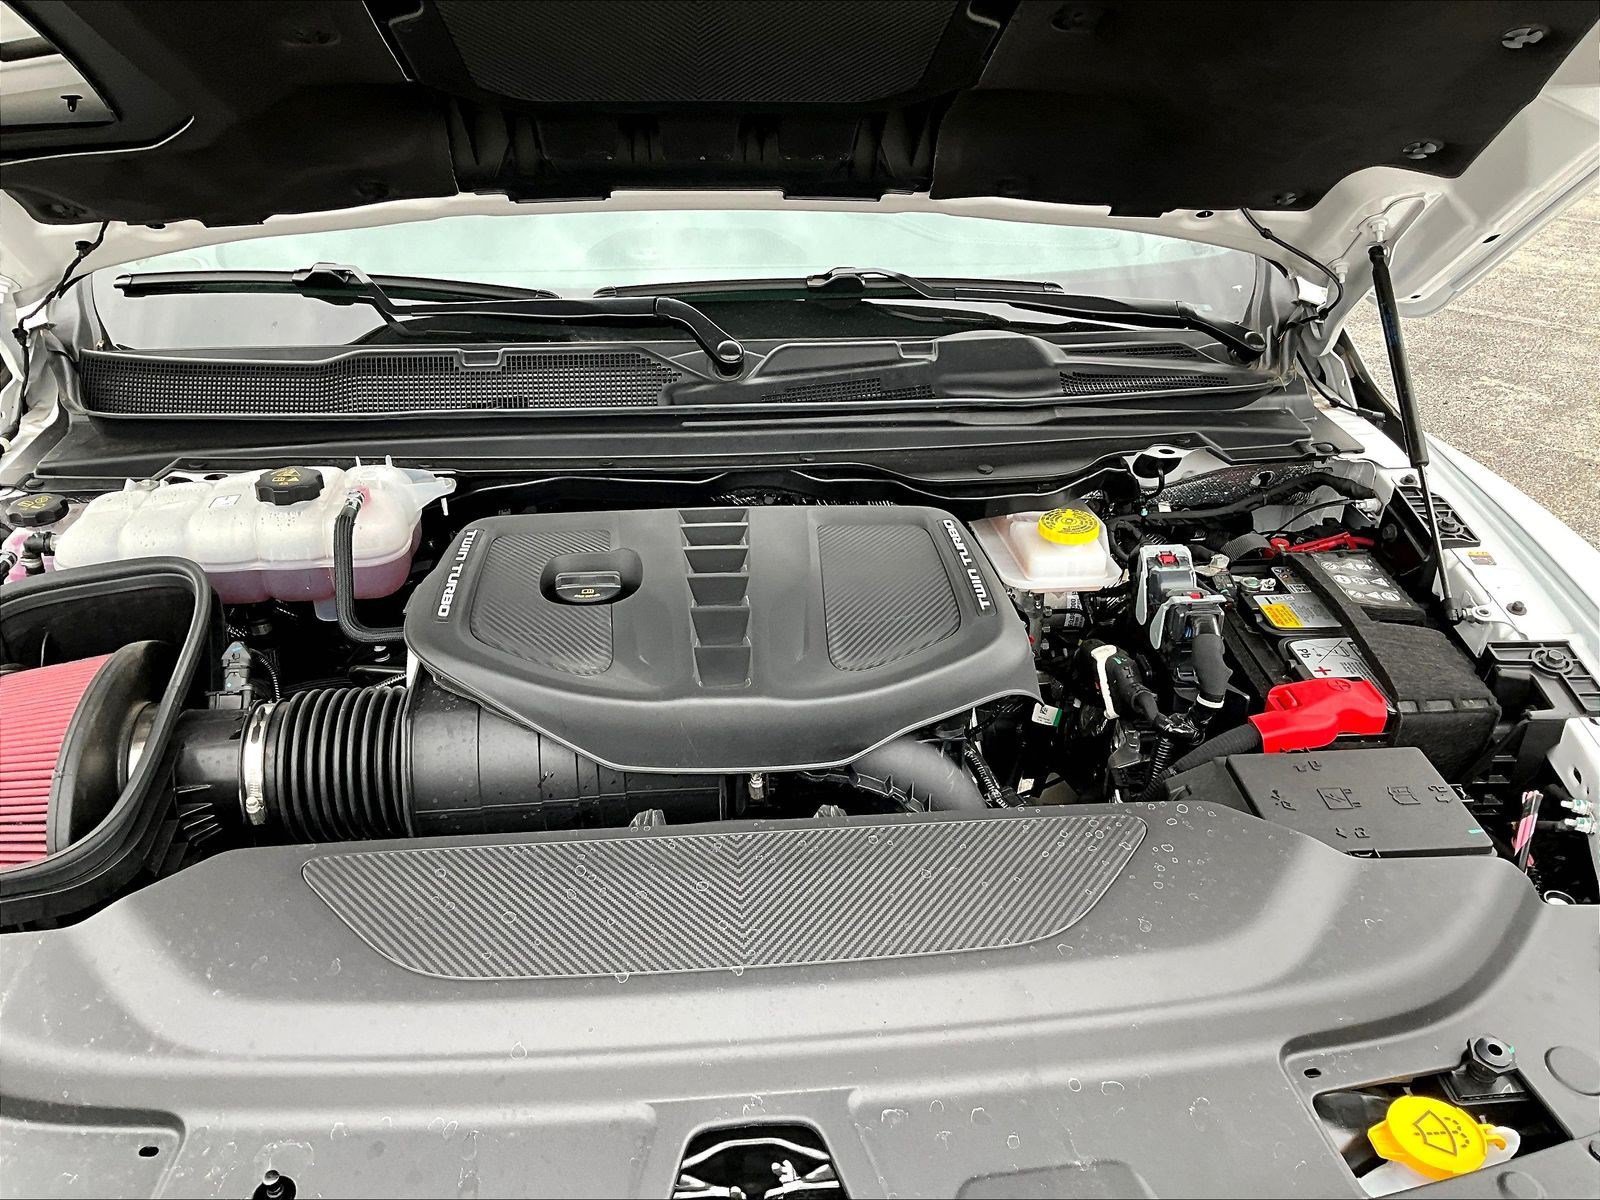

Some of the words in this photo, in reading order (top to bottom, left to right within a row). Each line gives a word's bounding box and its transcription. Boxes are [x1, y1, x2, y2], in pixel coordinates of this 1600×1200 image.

[455, 529, 478, 561] TWIN
[942, 519, 973, 566] TURBO
[437, 563, 464, 617] TURBO
[967, 568, 991, 611] TWIN
[1297, 648, 1311, 659] Pb
